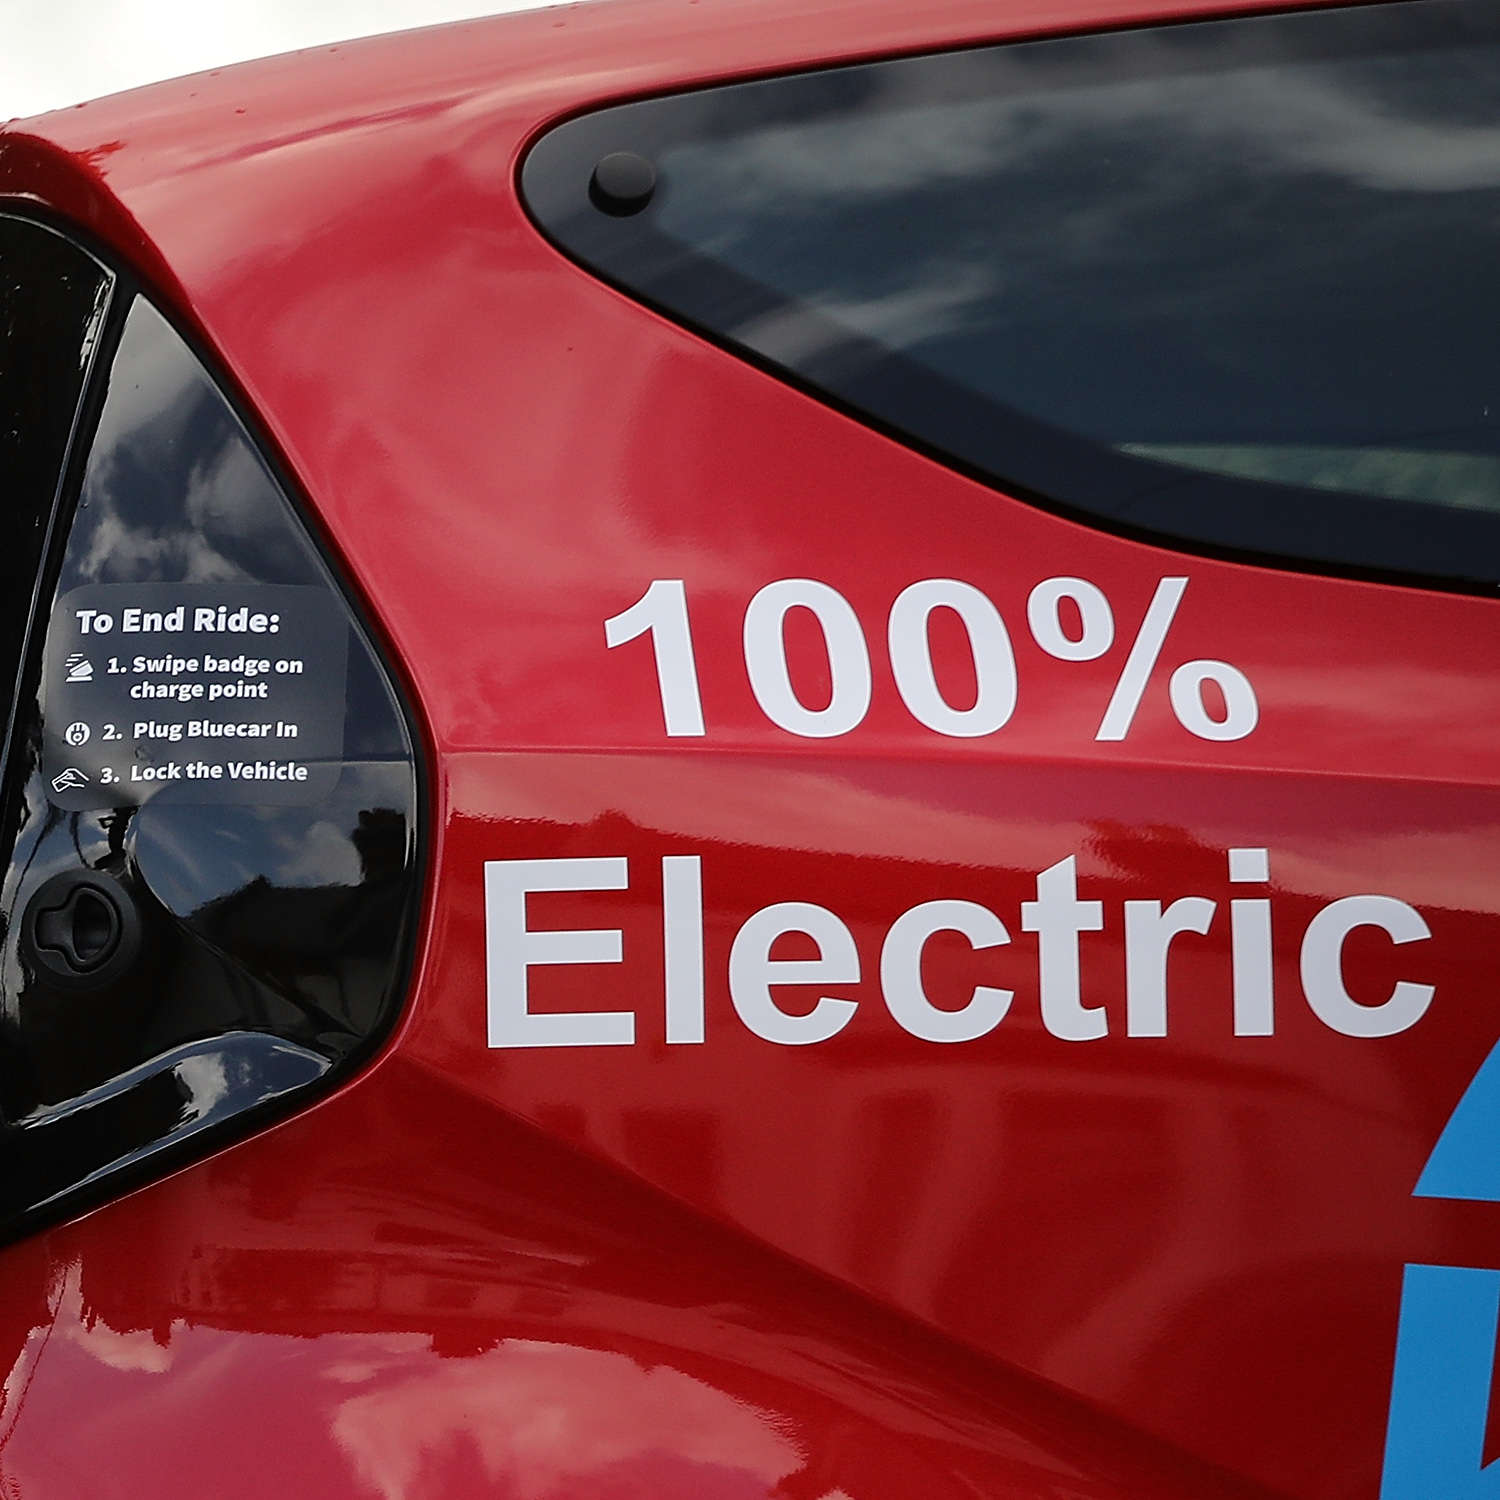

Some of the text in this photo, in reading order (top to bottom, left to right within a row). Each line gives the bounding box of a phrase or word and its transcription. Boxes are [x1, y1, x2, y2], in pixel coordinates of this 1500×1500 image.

[75, 606, 281, 635] To End Ride:
[106, 654, 303, 677] 1. Swipe badge on
[603, 576, 1260, 742] 100%
[129, 680, 269, 702] charge point
[102, 719, 299, 742] 2. Plug Bluecar In
[99, 761, 309, 784] 3. Lock the Vehicle
[483, 848, 1436, 1048] Electric
